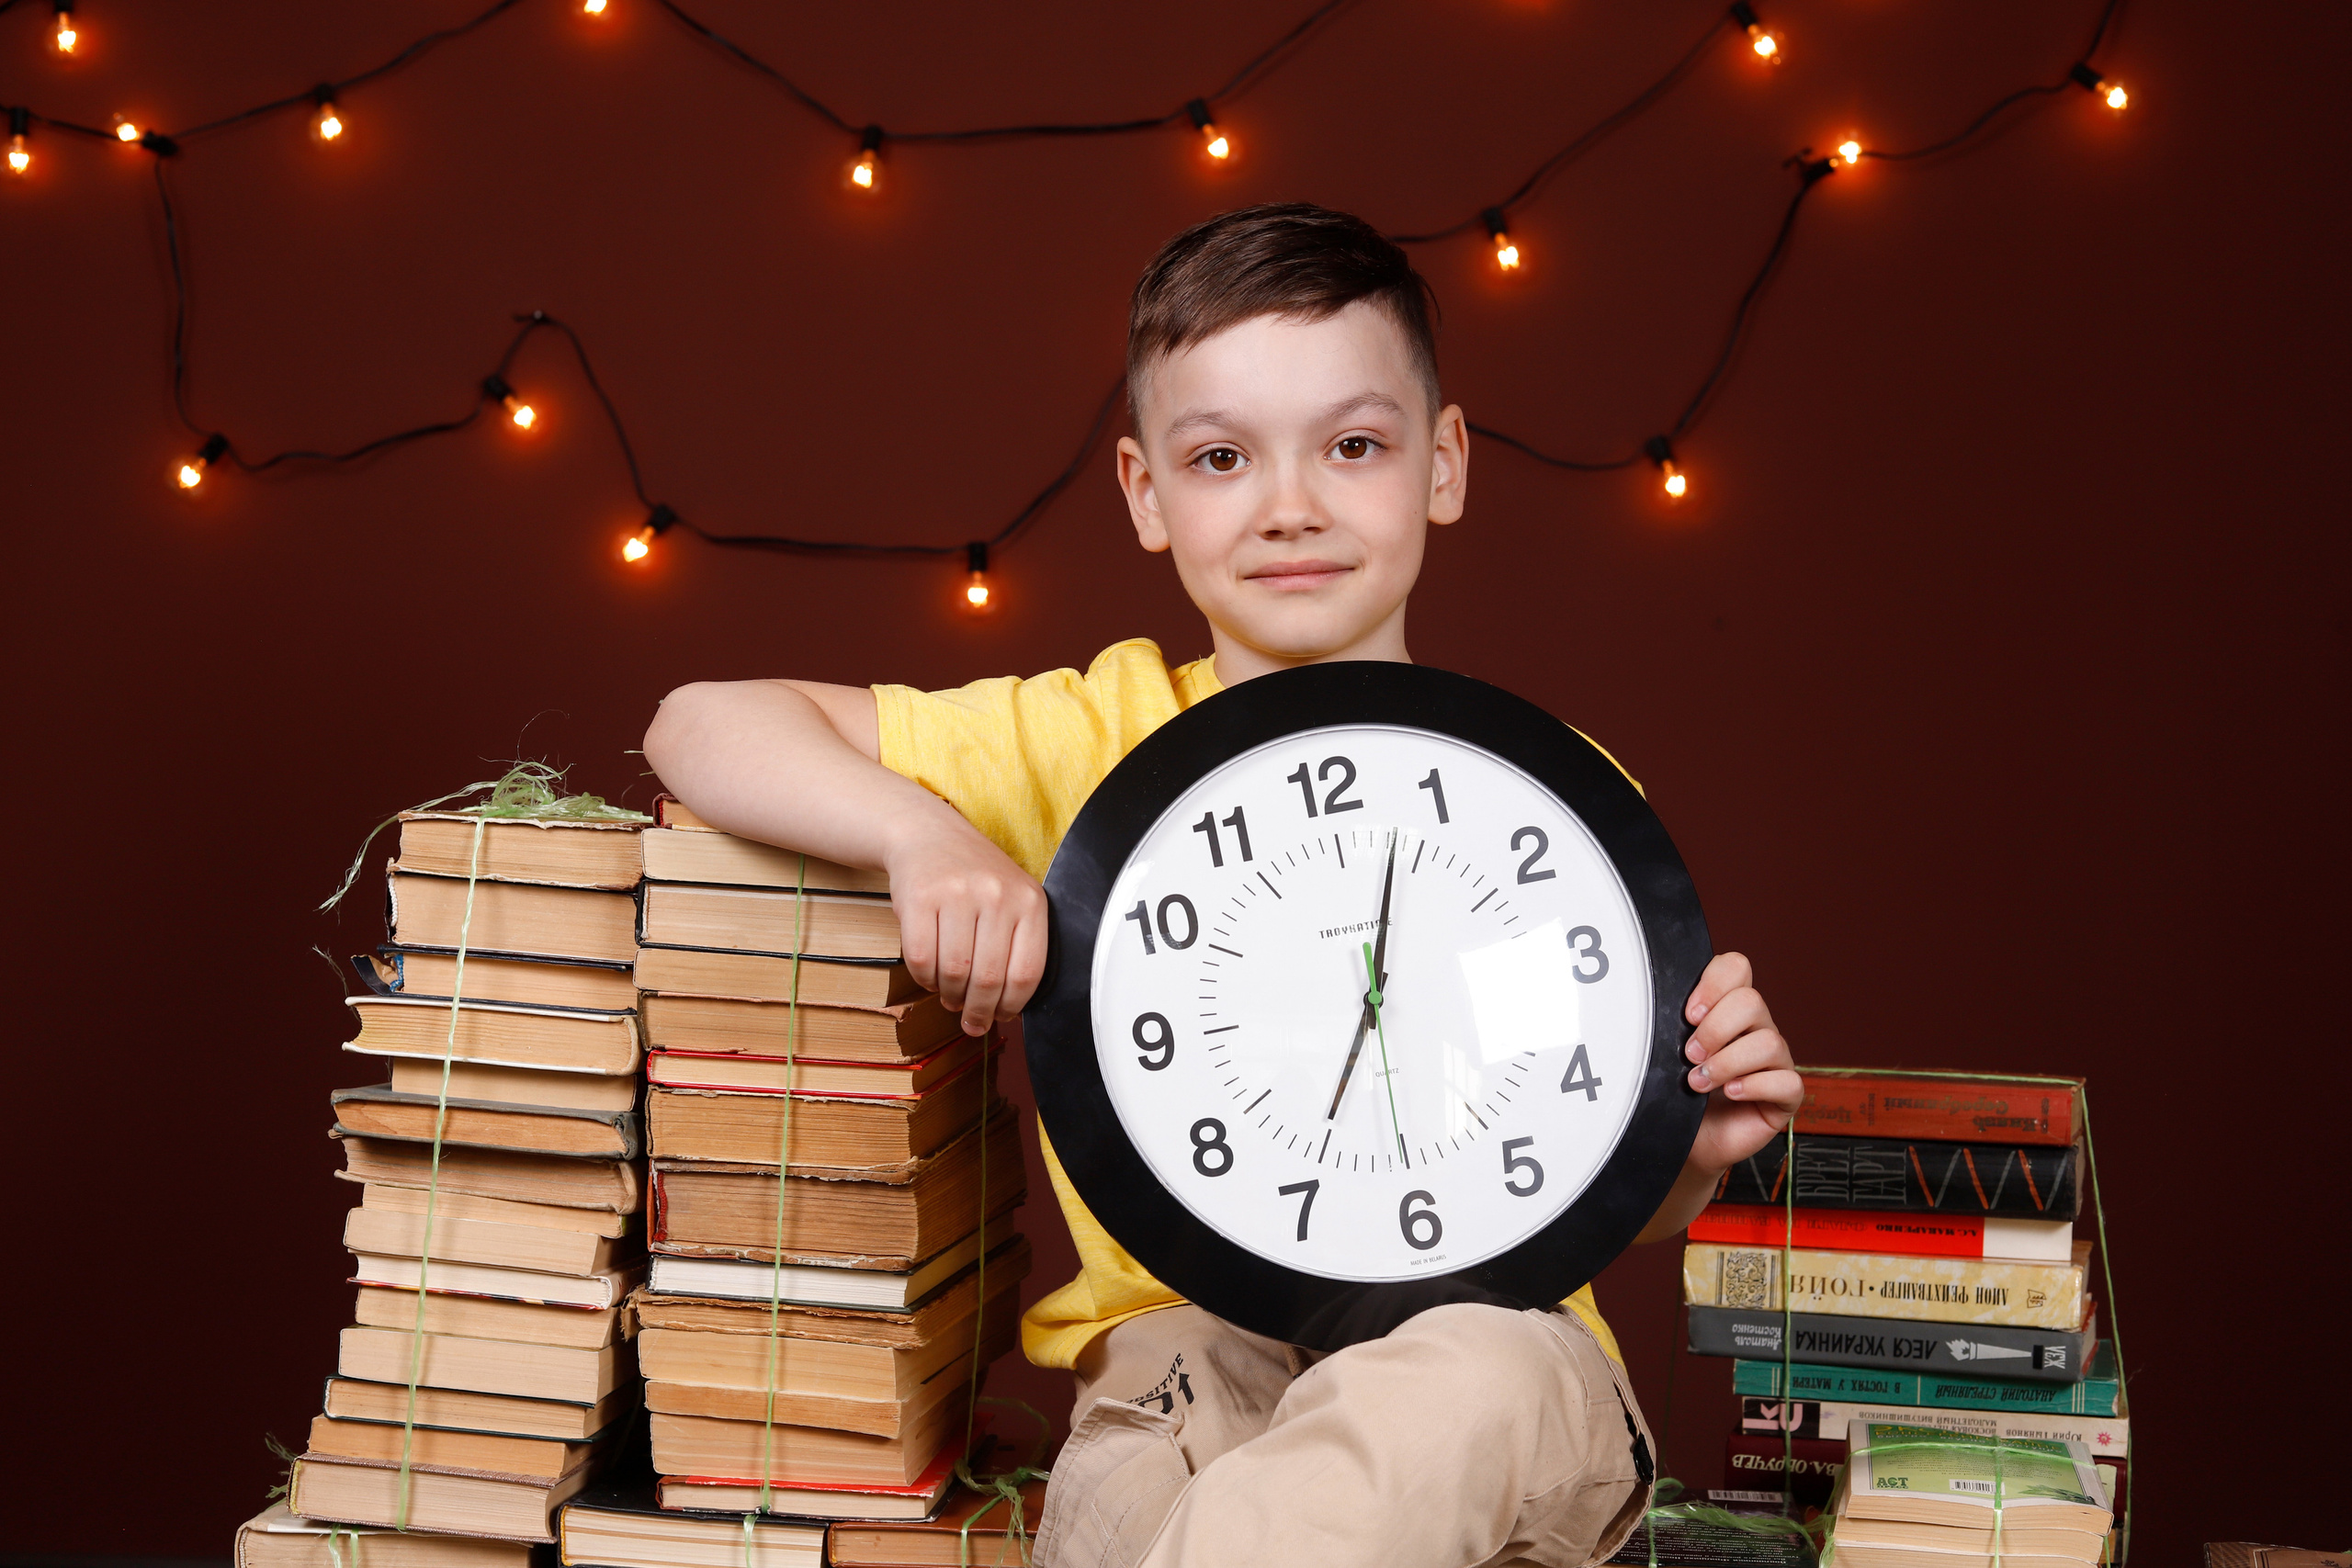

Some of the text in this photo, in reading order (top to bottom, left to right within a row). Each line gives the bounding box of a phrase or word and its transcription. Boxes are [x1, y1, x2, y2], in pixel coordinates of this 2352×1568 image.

[1286, 755, 1364, 818] 12
[1418, 768, 1450, 824] 1
[1193, 806, 1253, 868] 11
[1510, 826, 1556, 885] 2
[1124, 893, 1199, 955] 10
[1566, 925, 1610, 984] 3
[1132, 1011, 1175, 1071] 9
[1374, 1067, 1399, 1077] QURTZ
[1560, 1043, 1603, 1102] 4
[1190, 1117, 1234, 1177] 8
[1501, 1135, 1544, 1197] 5
[1796, 1142, 1850, 1202] БРЕТ
[1852, 1145, 1906, 1205] ГАРТ
[1278, 1179, 1320, 1242] 7
[1398, 1190, 1442, 1250] 6
[1430, 1254, 1447, 1263] BELARUS
[1789, 1274, 2008, 1306] ЛИОН ФЕЙХТВАНГЕР ГОЙЯ
[1732, 1324, 1782, 1339] Костенко
[1735, 1335, 1782, 1351] Анатоль
[1795, 1330, 1938, 1360] ЛЕСЯ УКРАИНКА
[2043, 1345, 2066, 1370] ЖЗЛ
[1792, 1376, 1901, 1393] В ГОСТЯХ У МАТЕРИ
[1935, 1384, 2056, 1402] АНАТОЛИЙ СТРЕЛЯНЫЙ
[1876, 1477, 1908, 1486] АСТ
